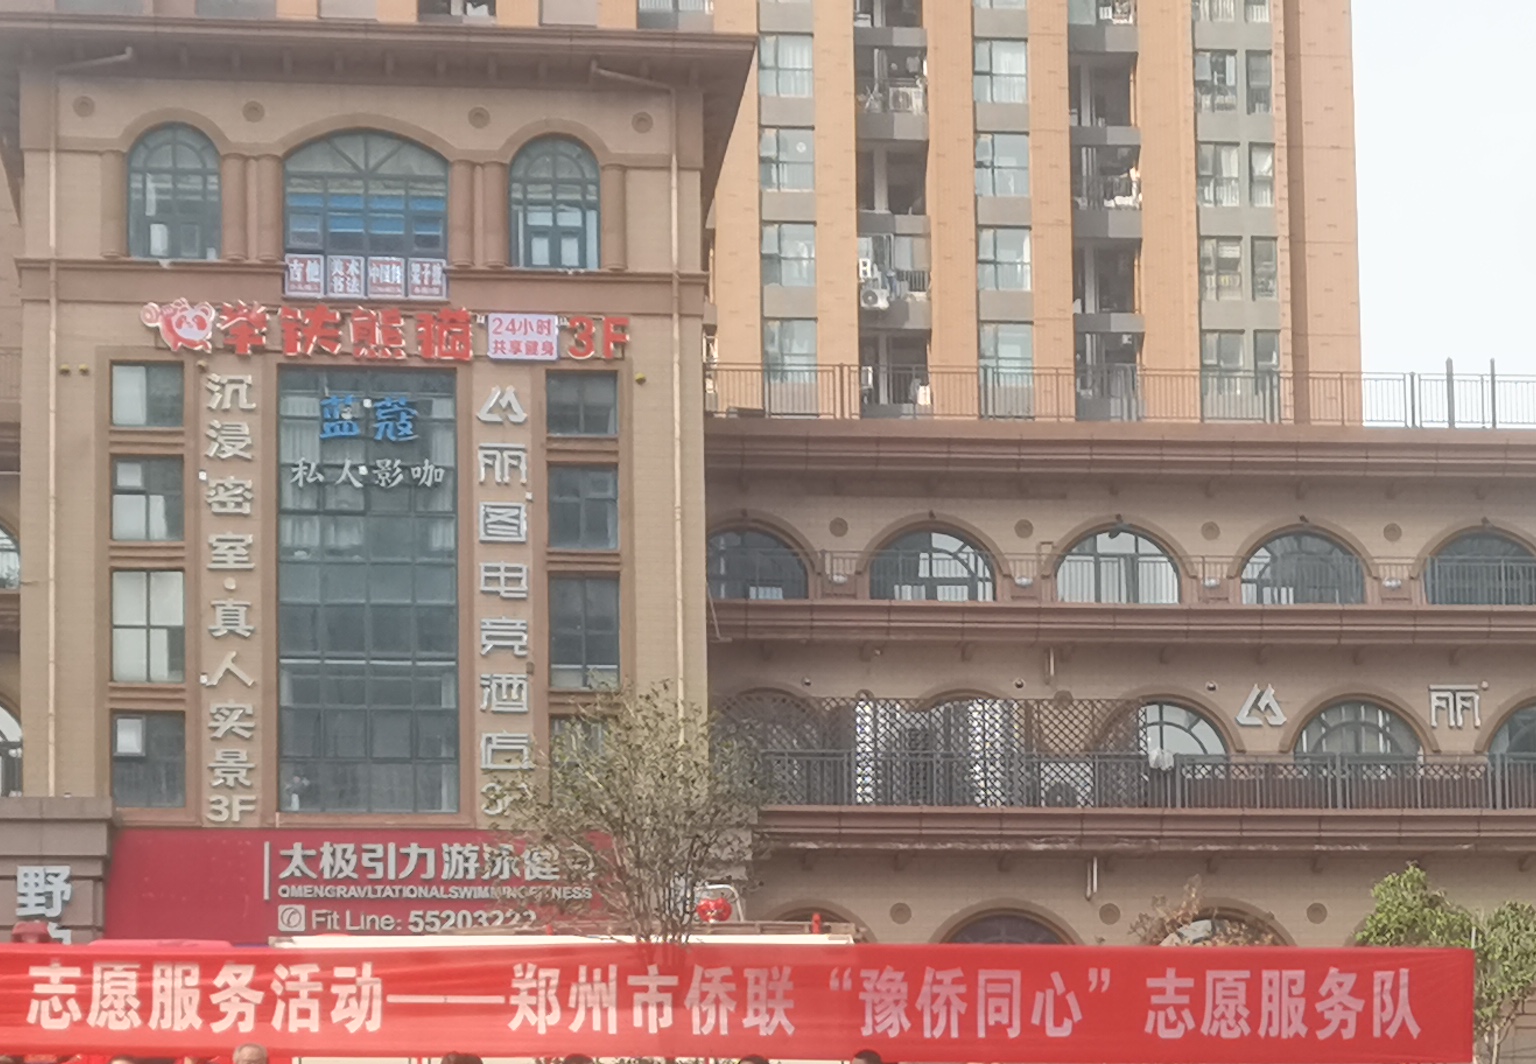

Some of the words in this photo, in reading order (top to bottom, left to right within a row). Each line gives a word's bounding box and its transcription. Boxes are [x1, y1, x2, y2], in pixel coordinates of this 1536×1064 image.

[492, 318, 553, 336] 24小时
[568, 315, 630, 359] 3F
[493, 339, 554, 357] 共享健身
[290, 457, 446, 489] 私人影咖
[278, 841, 595, 882] 太极引力游泳健
[312, 910, 340, 930] Fit
[346, 909, 402, 931] Line:
